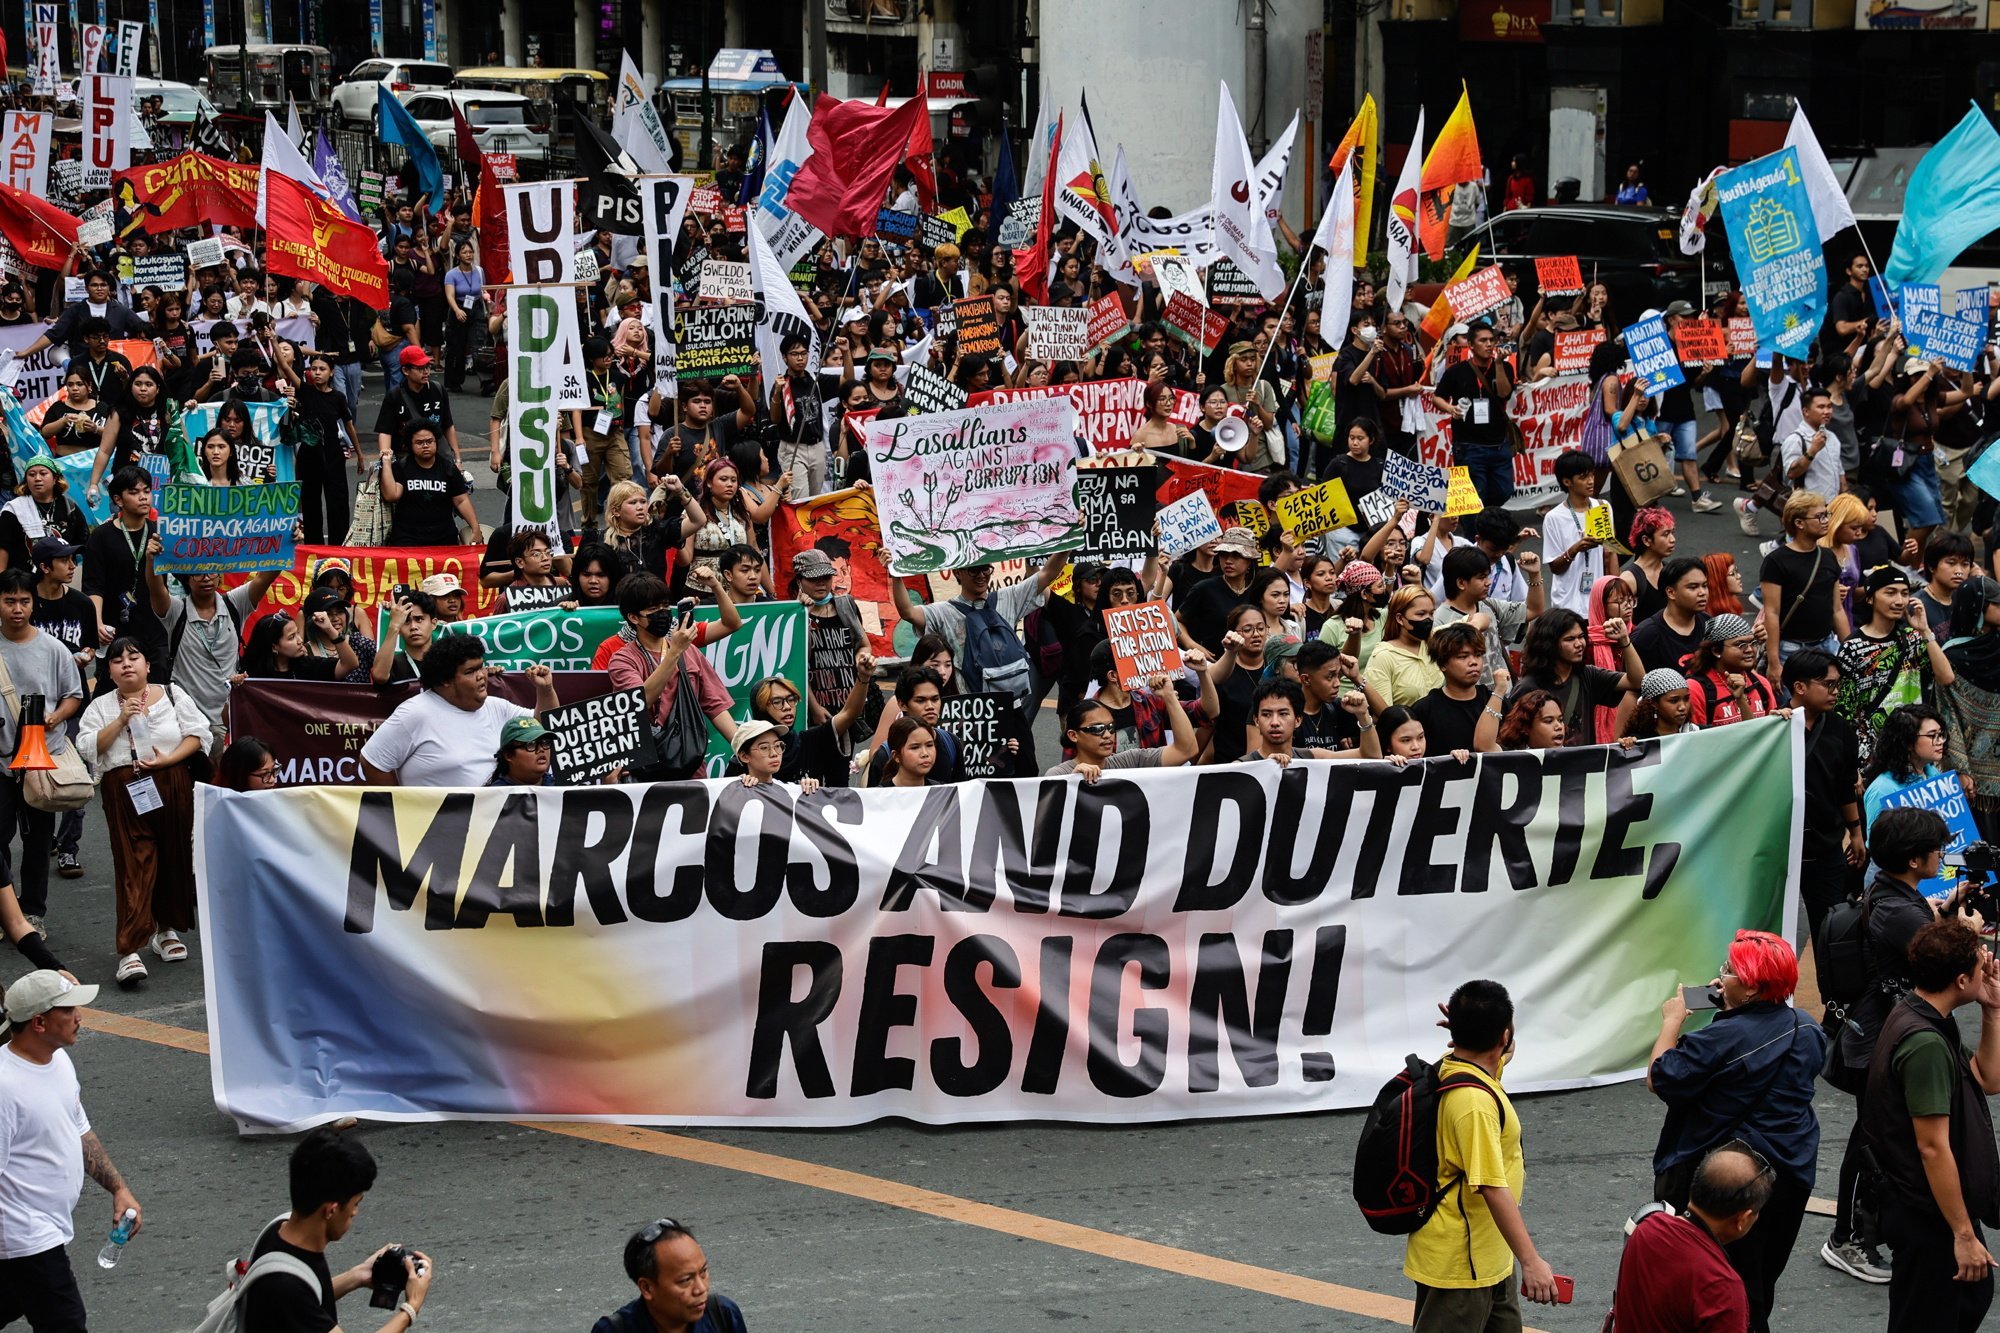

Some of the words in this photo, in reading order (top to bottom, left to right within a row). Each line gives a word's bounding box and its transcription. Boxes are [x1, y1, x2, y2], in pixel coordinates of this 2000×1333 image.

[92, 76, 115, 168] LPU
[1783, 156, 1801, 187] 1
[693, 192, 714, 201] STOP
[1225, 218, 1246, 240] DILIMAN
[272, 239, 307, 257] LEAGUE
[341, 267, 383, 289] STUDENTS
[1239, 242, 1261, 266] COUNCIL
[1752, 248, 1813, 283] EDUKASYONG
[296, 256, 316, 270] UP
[317, 265, 351, 291] MANILA
[703, 263, 744, 278] SWELDO
[702, 284, 723, 297] 50K
[727, 286, 754, 299] DAPAT
[1444, 267, 1498, 299] KABATAAN
[1486, 278, 1500, 290] SA
[1790, 281, 1818, 304] LAHAT
[1903, 286, 1939, 305] MARCOS
[1955, 289, 1989, 311] CONVICT
[955, 301, 993, 317] MAKIBAKA
[957, 321, 998, 341] PAMBANSANG
[1035, 323, 1053, 332] ANG
[1054, 323, 1078, 332] TUNAY
[1625, 318, 1665, 346] KABATAAN
[1913, 323, 1953, 342] QUALITY
[1959, 335, 1979, 349] FREE
[1921, 311, 1940, 326] WE
[1943, 318, 1980, 337] DESERVE
[713, 340, 727, 348] ANG
[1031, 334, 1044, 344] NA
[1047, 333, 1087, 345] LIBRENG
[1556, 333, 1587, 346] LAHAT
[1591, 332, 1604, 343] NG
[1562, 344, 1595, 356] SANGKOT
[1633, 335, 1668, 361] KONTRA
[1926, 338, 1974, 360] EDUCATION
[702, 368, 725, 377] SINING
[726, 365, 752, 375] MALATE
[1634, 348, 1679, 377] KORAPSYON
[910, 362, 969, 403] PANAGUTIN
[911, 376, 946, 400] LAHAT
[945, 394, 960, 410] NG
[517, 294, 559, 523] DLSU
[875, 416, 1028, 463] Lasallians
[941, 445, 1014, 470] AGAINST
[1390, 451, 1424, 474] PONDO
[1424, 466, 1442, 478] SA
[964, 462, 1061, 493] CORRUPTION
[1115, 474, 1139, 490] NA
[1384, 461, 1449, 489] EDUKASYON
[1386, 473, 1410, 493] HINDI
[1412, 485, 1430, 496] SA
[1449, 467, 1466, 479] TAO
[407, 479, 447, 493] BENILDE
[1380, 482, 1447, 512] KORAPSYON
[162, 482, 302, 516] BENILDEANS
[1120, 493, 1136, 505] SA
[1283, 484, 1330, 516] SERVE
[1177, 509, 1210, 533] BAYAN
[1293, 508, 1341, 537] PEOPLE
[1295, 504, 1321, 522] THE
[157, 516, 202, 537] FIGHT
[202, 518, 244, 538] BACK
[243, 516, 298, 534] AGAINST
[173, 534, 283, 559] CORRUPTION
[1073, 553, 1105, 563] SINING
[1108, 552, 1147, 561] MALATE
[237, 561, 258, 570] VITO
[258, 560, 283, 568] CRUZ
[1108, 604, 1169, 637] ARTISTS,
[824, 627, 851, 646] HAVE
[1137, 630, 1175, 653] ACTION
[814, 648, 855, 669] ANNUALLY
[1134, 652, 1166, 675] NOW!
[547, 688, 646, 730] MARCOS
[304, 724, 330, 736] ONE
[335, 723, 370, 736] TAFT
[553, 711, 641, 751] DUTERTE
[344, 738, 361, 750] AT
[557, 733, 642, 771] RESIGN!
[277, 757, 366, 784] MARC
[343, 781, 863, 934] MARCOS
[878, 777, 1151, 919] AND
[1173, 739, 1682, 913] DUTERTE,
[745, 924, 1347, 1101] RESIGN!
